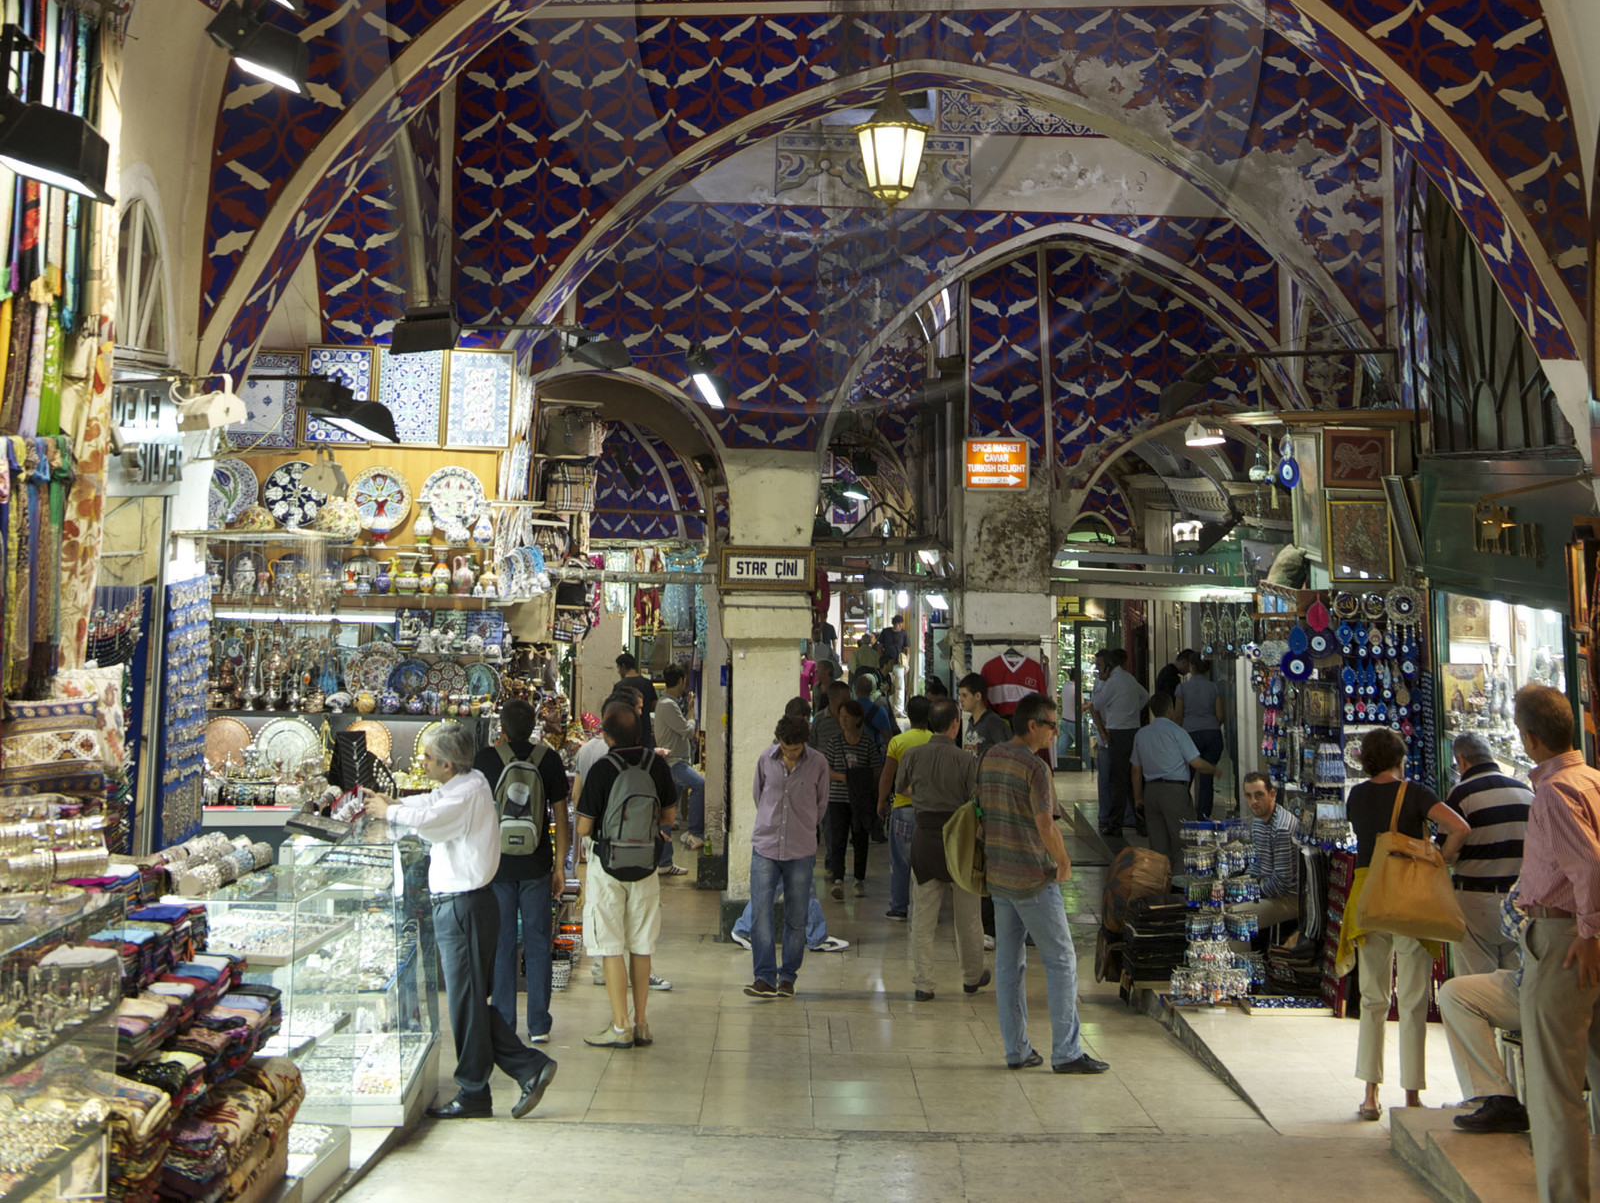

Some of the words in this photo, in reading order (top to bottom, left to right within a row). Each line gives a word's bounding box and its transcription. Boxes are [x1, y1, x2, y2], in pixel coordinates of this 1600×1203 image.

[972, 444, 992, 452] SPICE
[993, 444, 1021, 452] MARKET
[136, 443, 183, 482] SILVER
[984, 454, 1009, 462] CAVIAR
[968, 464, 996, 472] TURKISH
[997, 464, 1025, 473] DELIGHT
[736, 561, 768, 575] STAR
[775, 559, 798, 579] ÇİNİ
